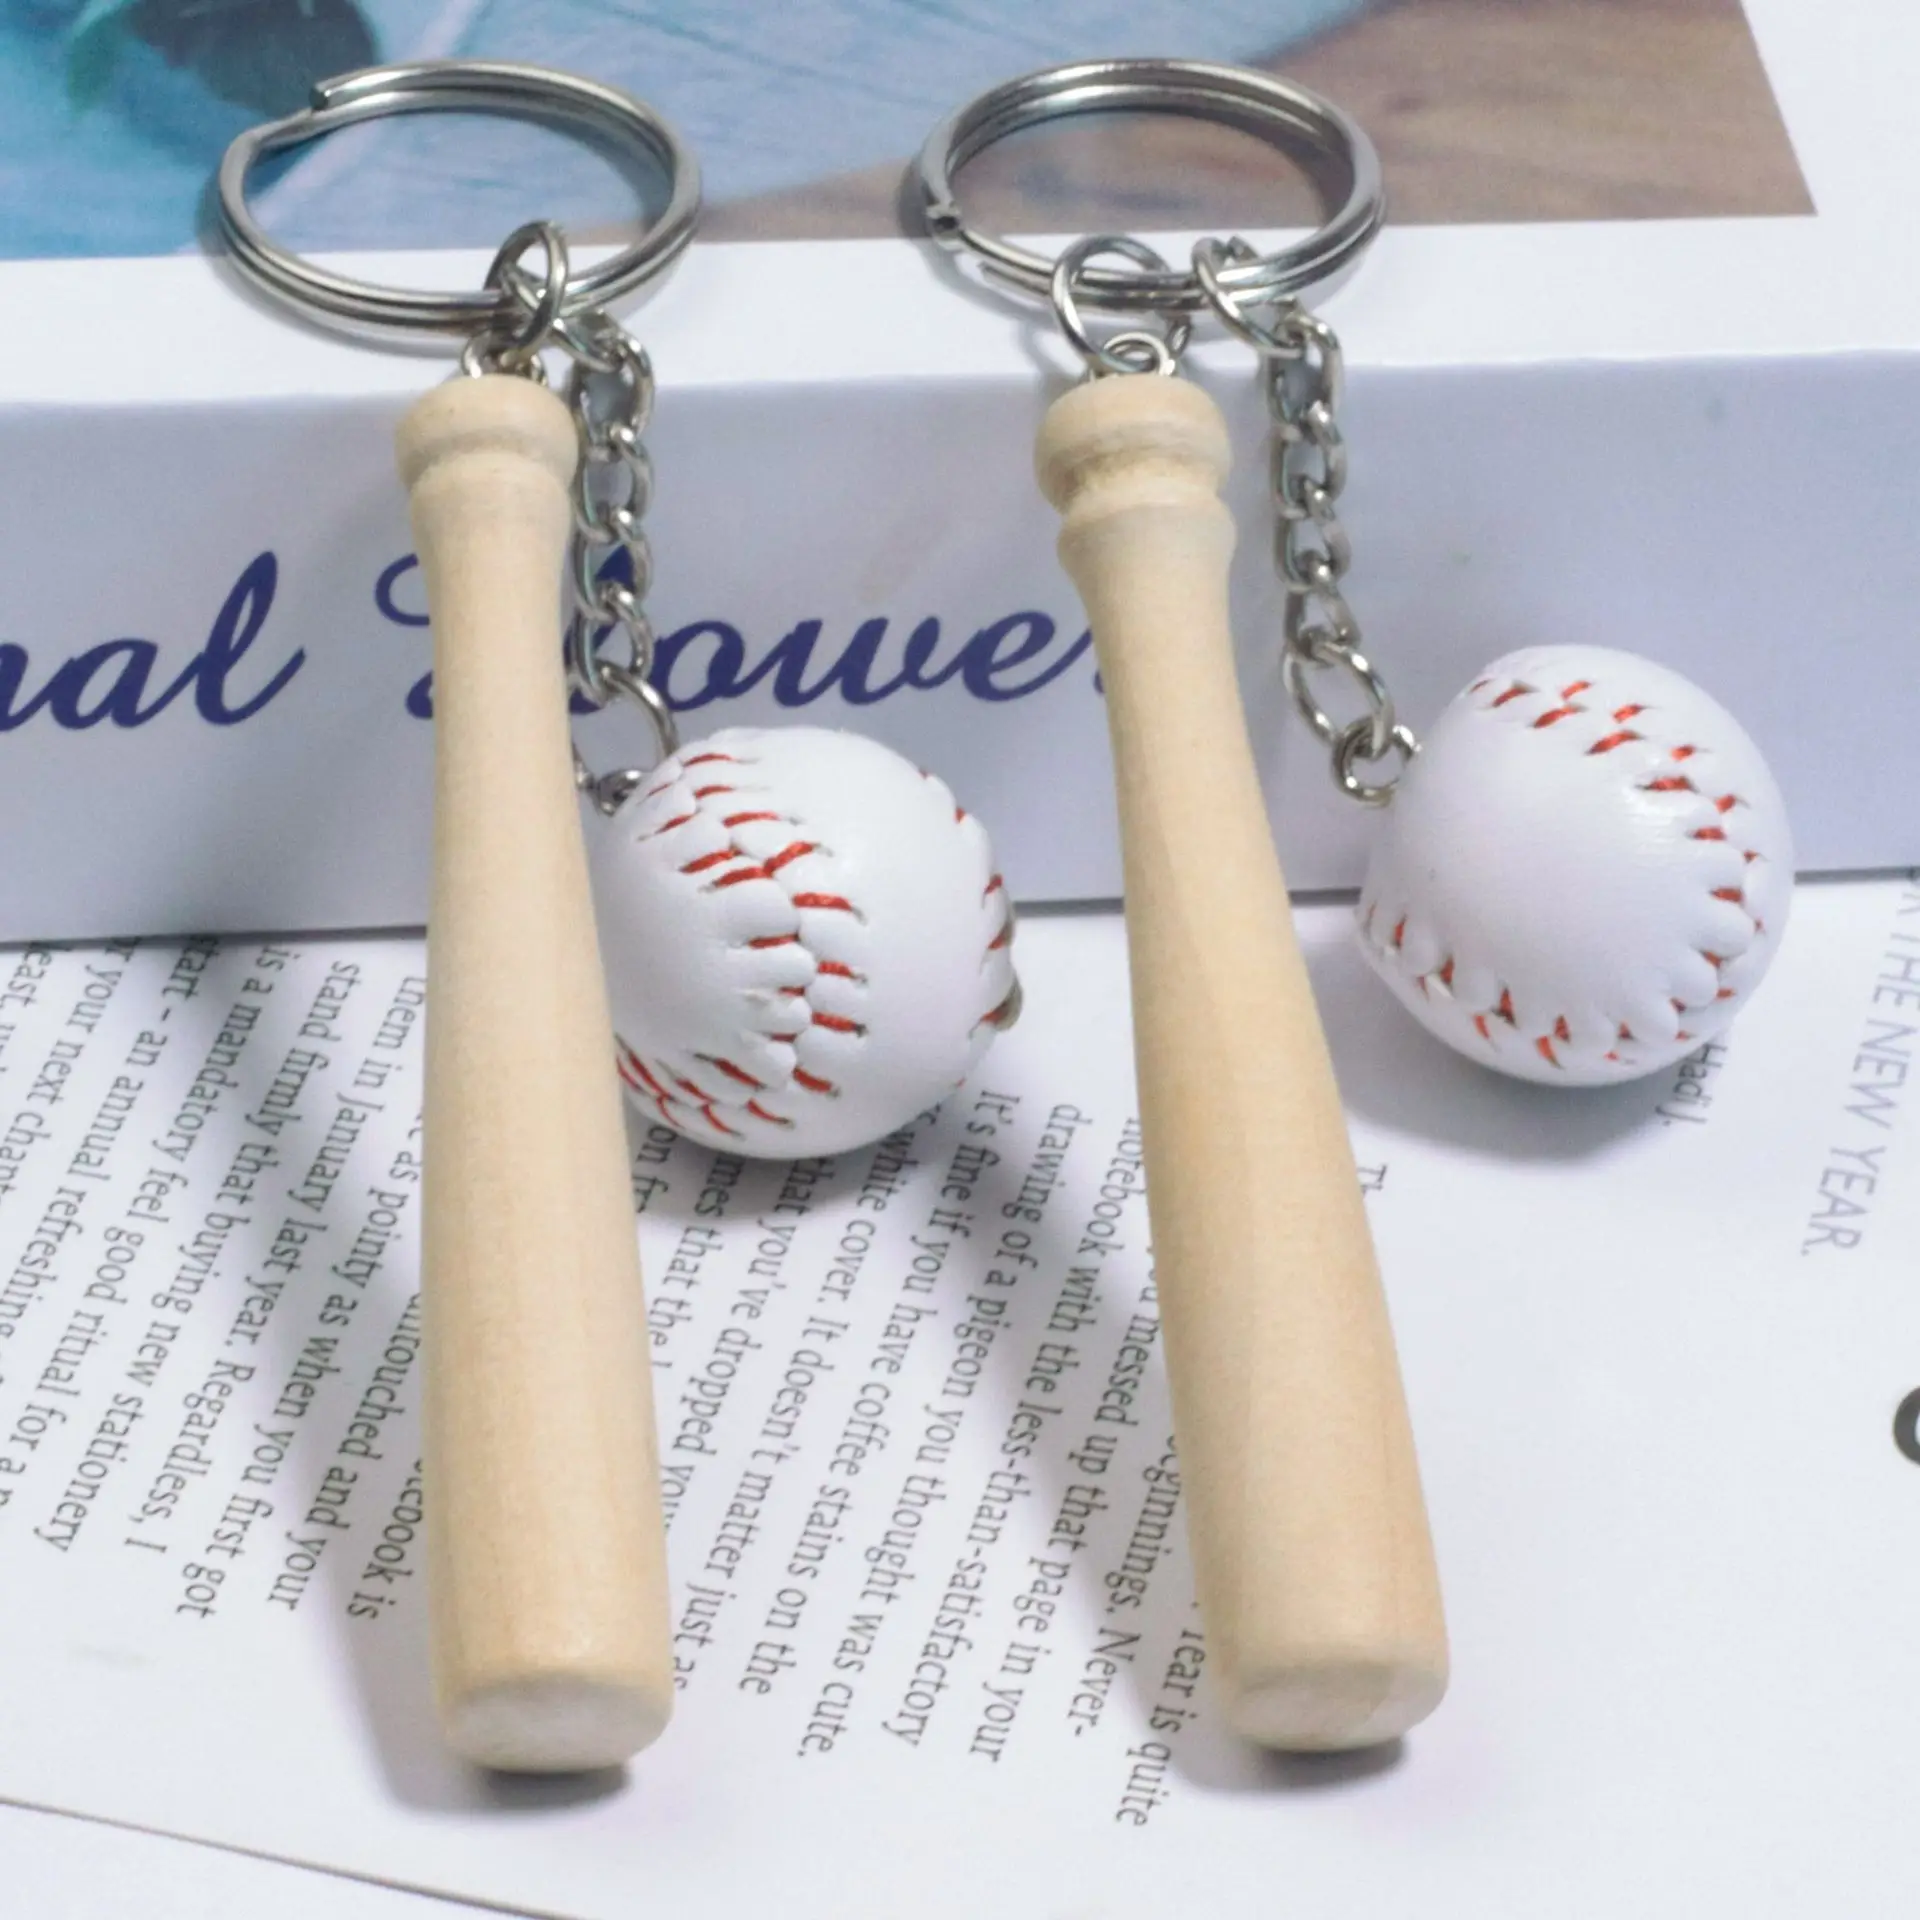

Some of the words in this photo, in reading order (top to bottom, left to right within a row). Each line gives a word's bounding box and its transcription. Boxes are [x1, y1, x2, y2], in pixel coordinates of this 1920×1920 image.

[240, 977, 275, 995] a
[255, 947, 298, 972] is
[64, 963, 123, 1035] your
[296, 960, 361, 1043] stand
[25, 1039, 85, 1105] next
[124, 1030, 169, 1067] an
[150, 1002, 262, 1163] mandatory
[352, 1057, 401, 1089] in
[1843, 1017, 1918, 1130] NEW
[243, 1046, 330, 1137] firmly
[965, 1089, 1021, 1137] It's
[65, 1075, 145, 1182] annual
[286, 1091, 385, 1213] January
[1001, 1103, 1094, 1222] drawing
[125, 1167, 189, 1224] feel
[214, 1141, 280, 1206] that
[855, 1131, 920, 1211] white
[940, 1143, 1000, 1199] fine
[1801, 1145, 1887, 1256] YEAR.
[262, 1217, 329, 1275] last
[330, 1186, 410, 1290] pointy
[661, 1225, 724, 1290] that
[927, 1207, 975, 1238] if
[993, 1229, 1039, 1269] of
[82, 1225, 145, 1305] good
[149, 1211, 252, 1314] buying
[729, 1217, 797, 1319] you've
[816, 1218, 877, 1303] cover.
[901, 1233, 951, 1294] you
[983, 1269, 1018, 1287] a
[223, 1274, 286, 1347] year.
[317, 1293, 359, 1327] as
[648, 1296, 693, 1347] the
[801, 1315, 851, 1343] It
[1045, 1266, 1102, 1333] with
[34, 1308, 108, 1398] ritual
[124, 1319, 182, 1388] new
[869, 1302, 939, 1374] have
[940, 1293, 1012, 1398] pigeon
[1024, 1342, 1081, 1393] the
[1093, 1313, 1160, 1427] messed
[272, 1336, 342, 1419] when
[671, 1327, 764, 1457] dropped
[750, 1348, 836, 1464] doesn't
[8, 1402, 68, 1452] for
[128, 1358, 257, 1525] Regardless,
[239, 1422, 296, 1485] you
[827, 1381, 892, 1476] coffee
[914, 1402, 964, 1464] you
[1066, 1433, 1118, 1475] up
[0, 1456, 28, 1476] a
[32, 1392, 145, 1553] stationery
[303, 1466, 359, 1531] and
[660, 1464, 696, 1534] you
[122, 1536, 169, 1554] I
[204, 1492, 275, 1560] first
[703, 1469, 773, 1580] matter
[786, 1483, 853, 1580] stains
[858, 1473, 948, 1605] thought
[1046, 1483, 1109, 1553] that
[174, 1561, 226, 1619] got
[265, 1530, 328, 1612] your
[346, 1590, 397, 1620] is
[880, 1399, 1064, 1747] less-than-satisfactory
[1012, 1555, 1072, 1633] page
[672, 1581, 738, 1649] just
[763, 1587, 809, 1630] on
[831, 1613, 885, 1673] was
[737, 1640, 798, 1695] the
[999, 1640, 1053, 1676] in
[1066, 1626, 1142, 1737] Never-
[795, 1681, 854, 1758] cute.
[968, 1680, 1025, 1764] your
[1148, 1703, 1198, 1733] is
[1114, 1741, 1172, 1827] quite
